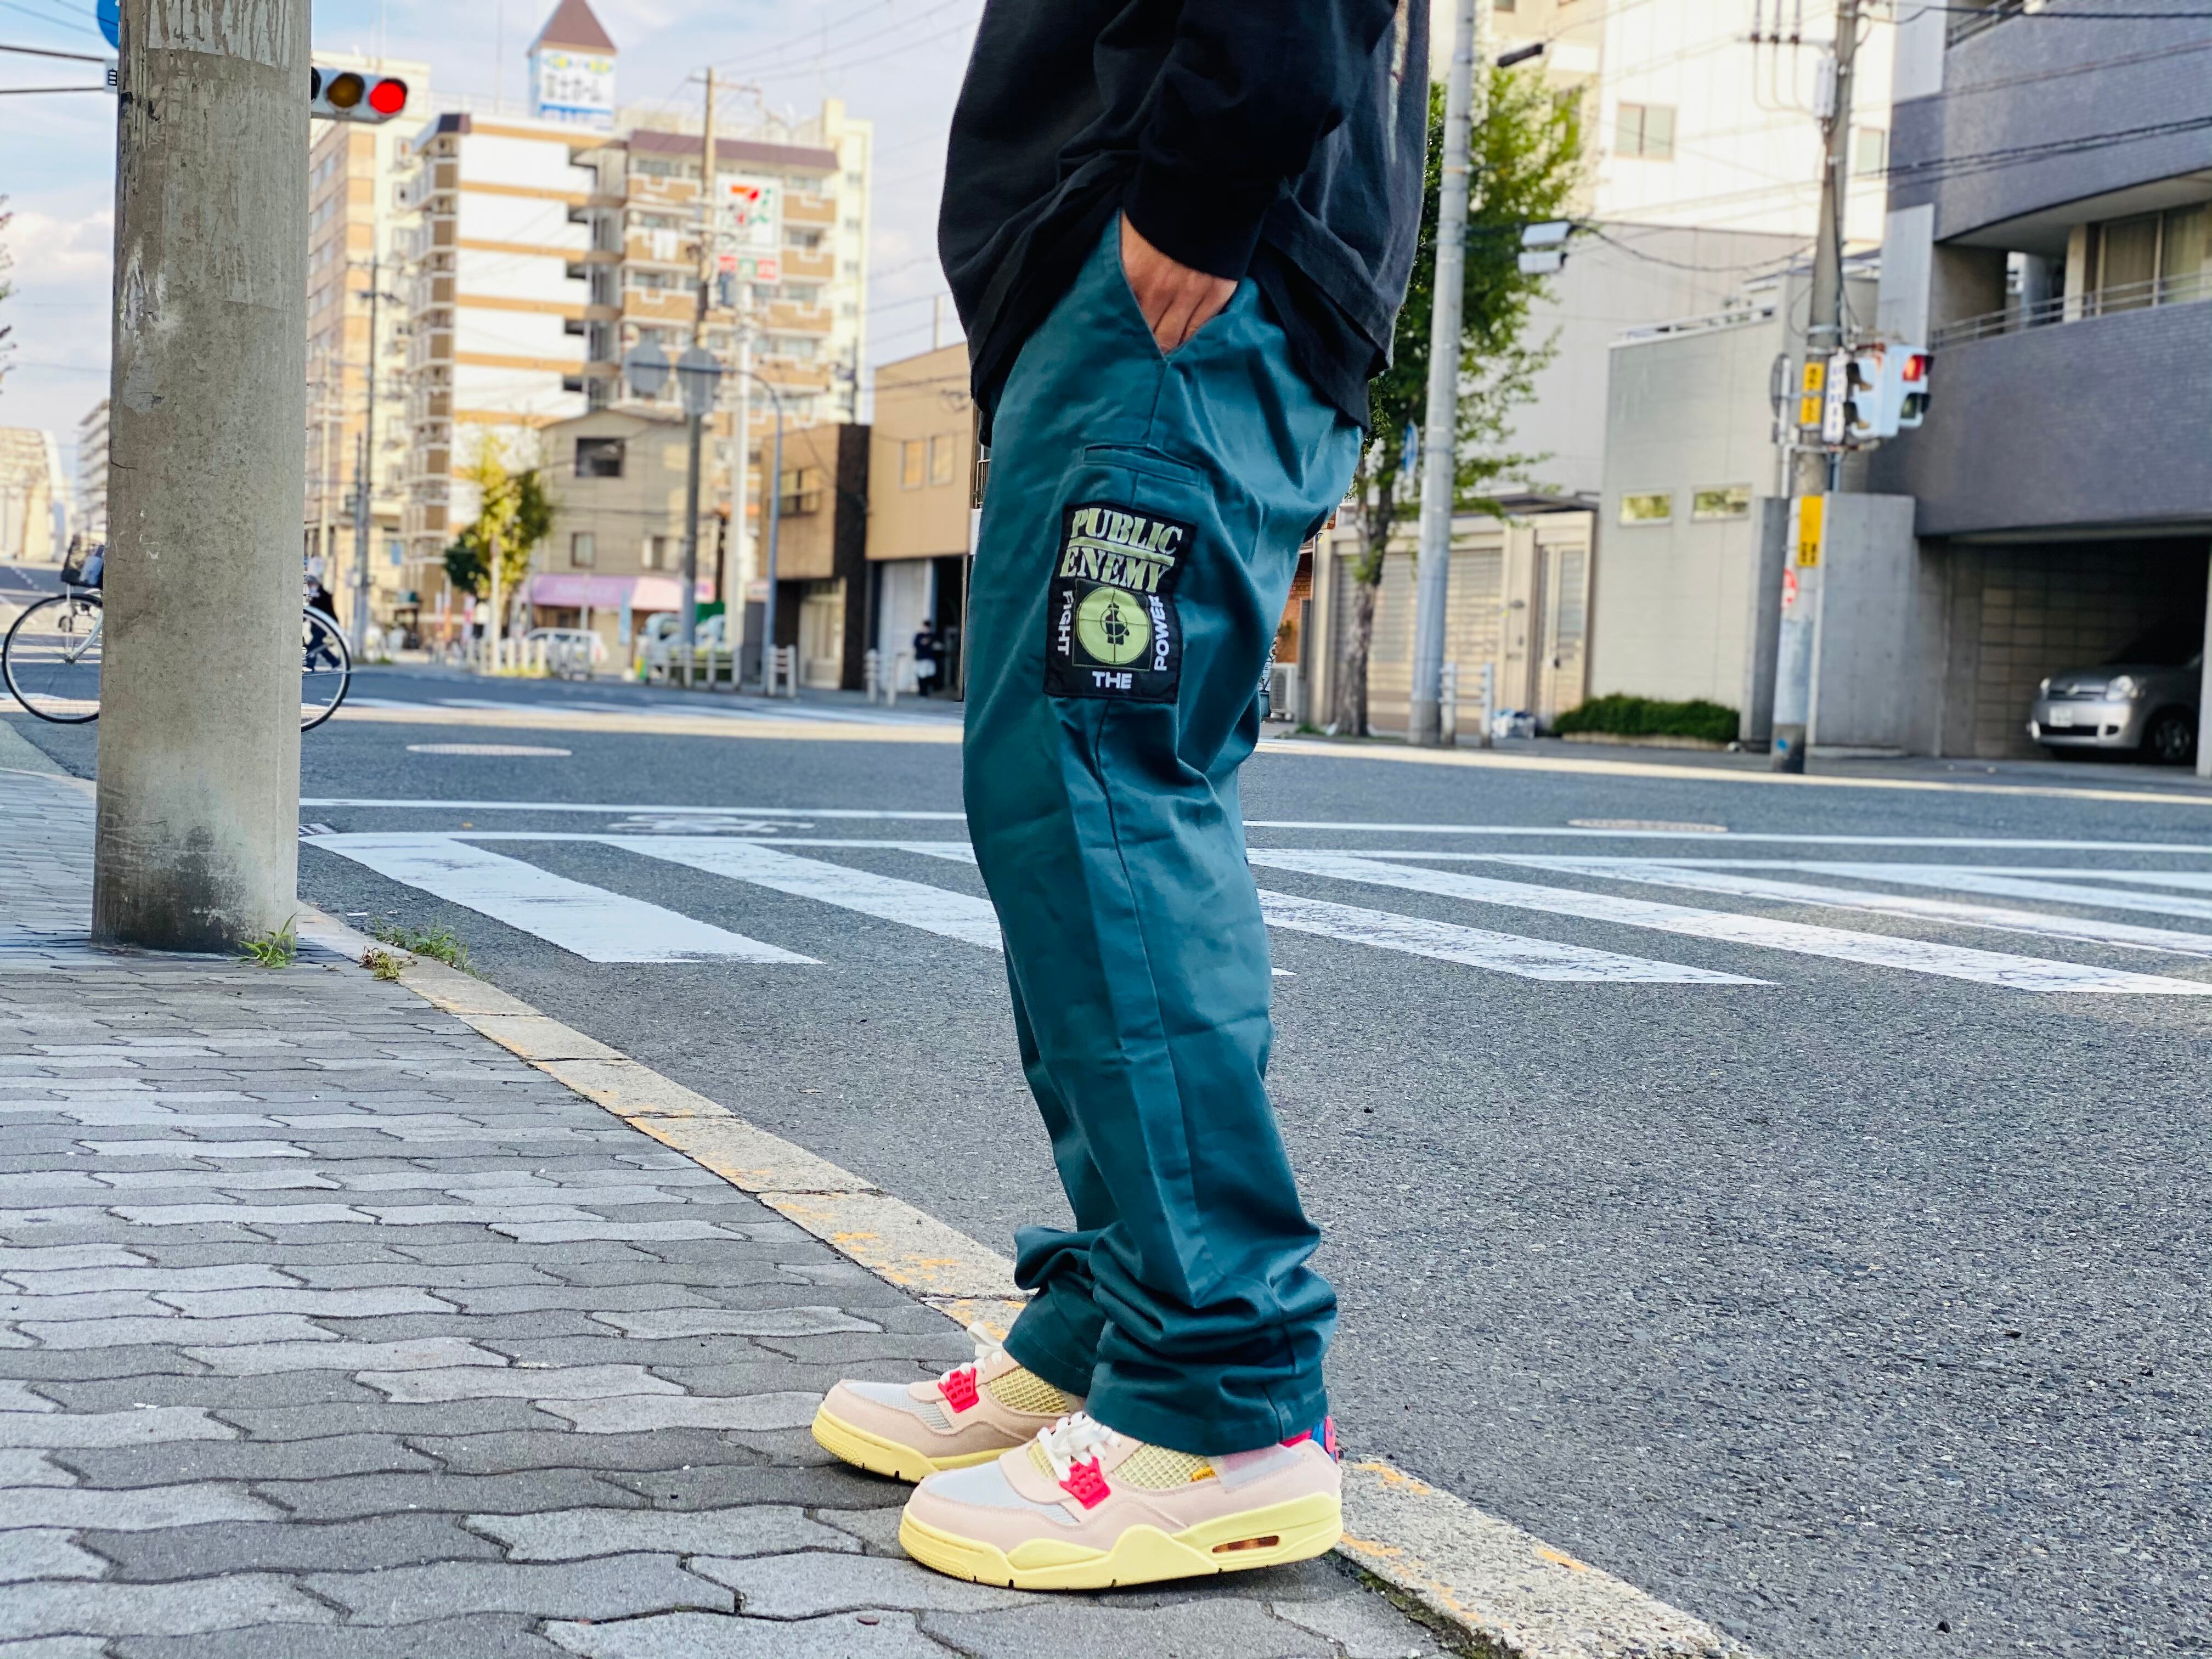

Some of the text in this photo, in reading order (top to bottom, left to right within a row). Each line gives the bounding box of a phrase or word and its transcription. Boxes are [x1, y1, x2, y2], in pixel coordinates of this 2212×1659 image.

[1070, 507, 1183, 555] PUBLIC
[1059, 546, 1171, 593] ENEMY
[1057, 590, 1074, 656] FIGHT
[1147, 594, 1170, 672] POWER
[1091, 670, 1133, 689] THE
